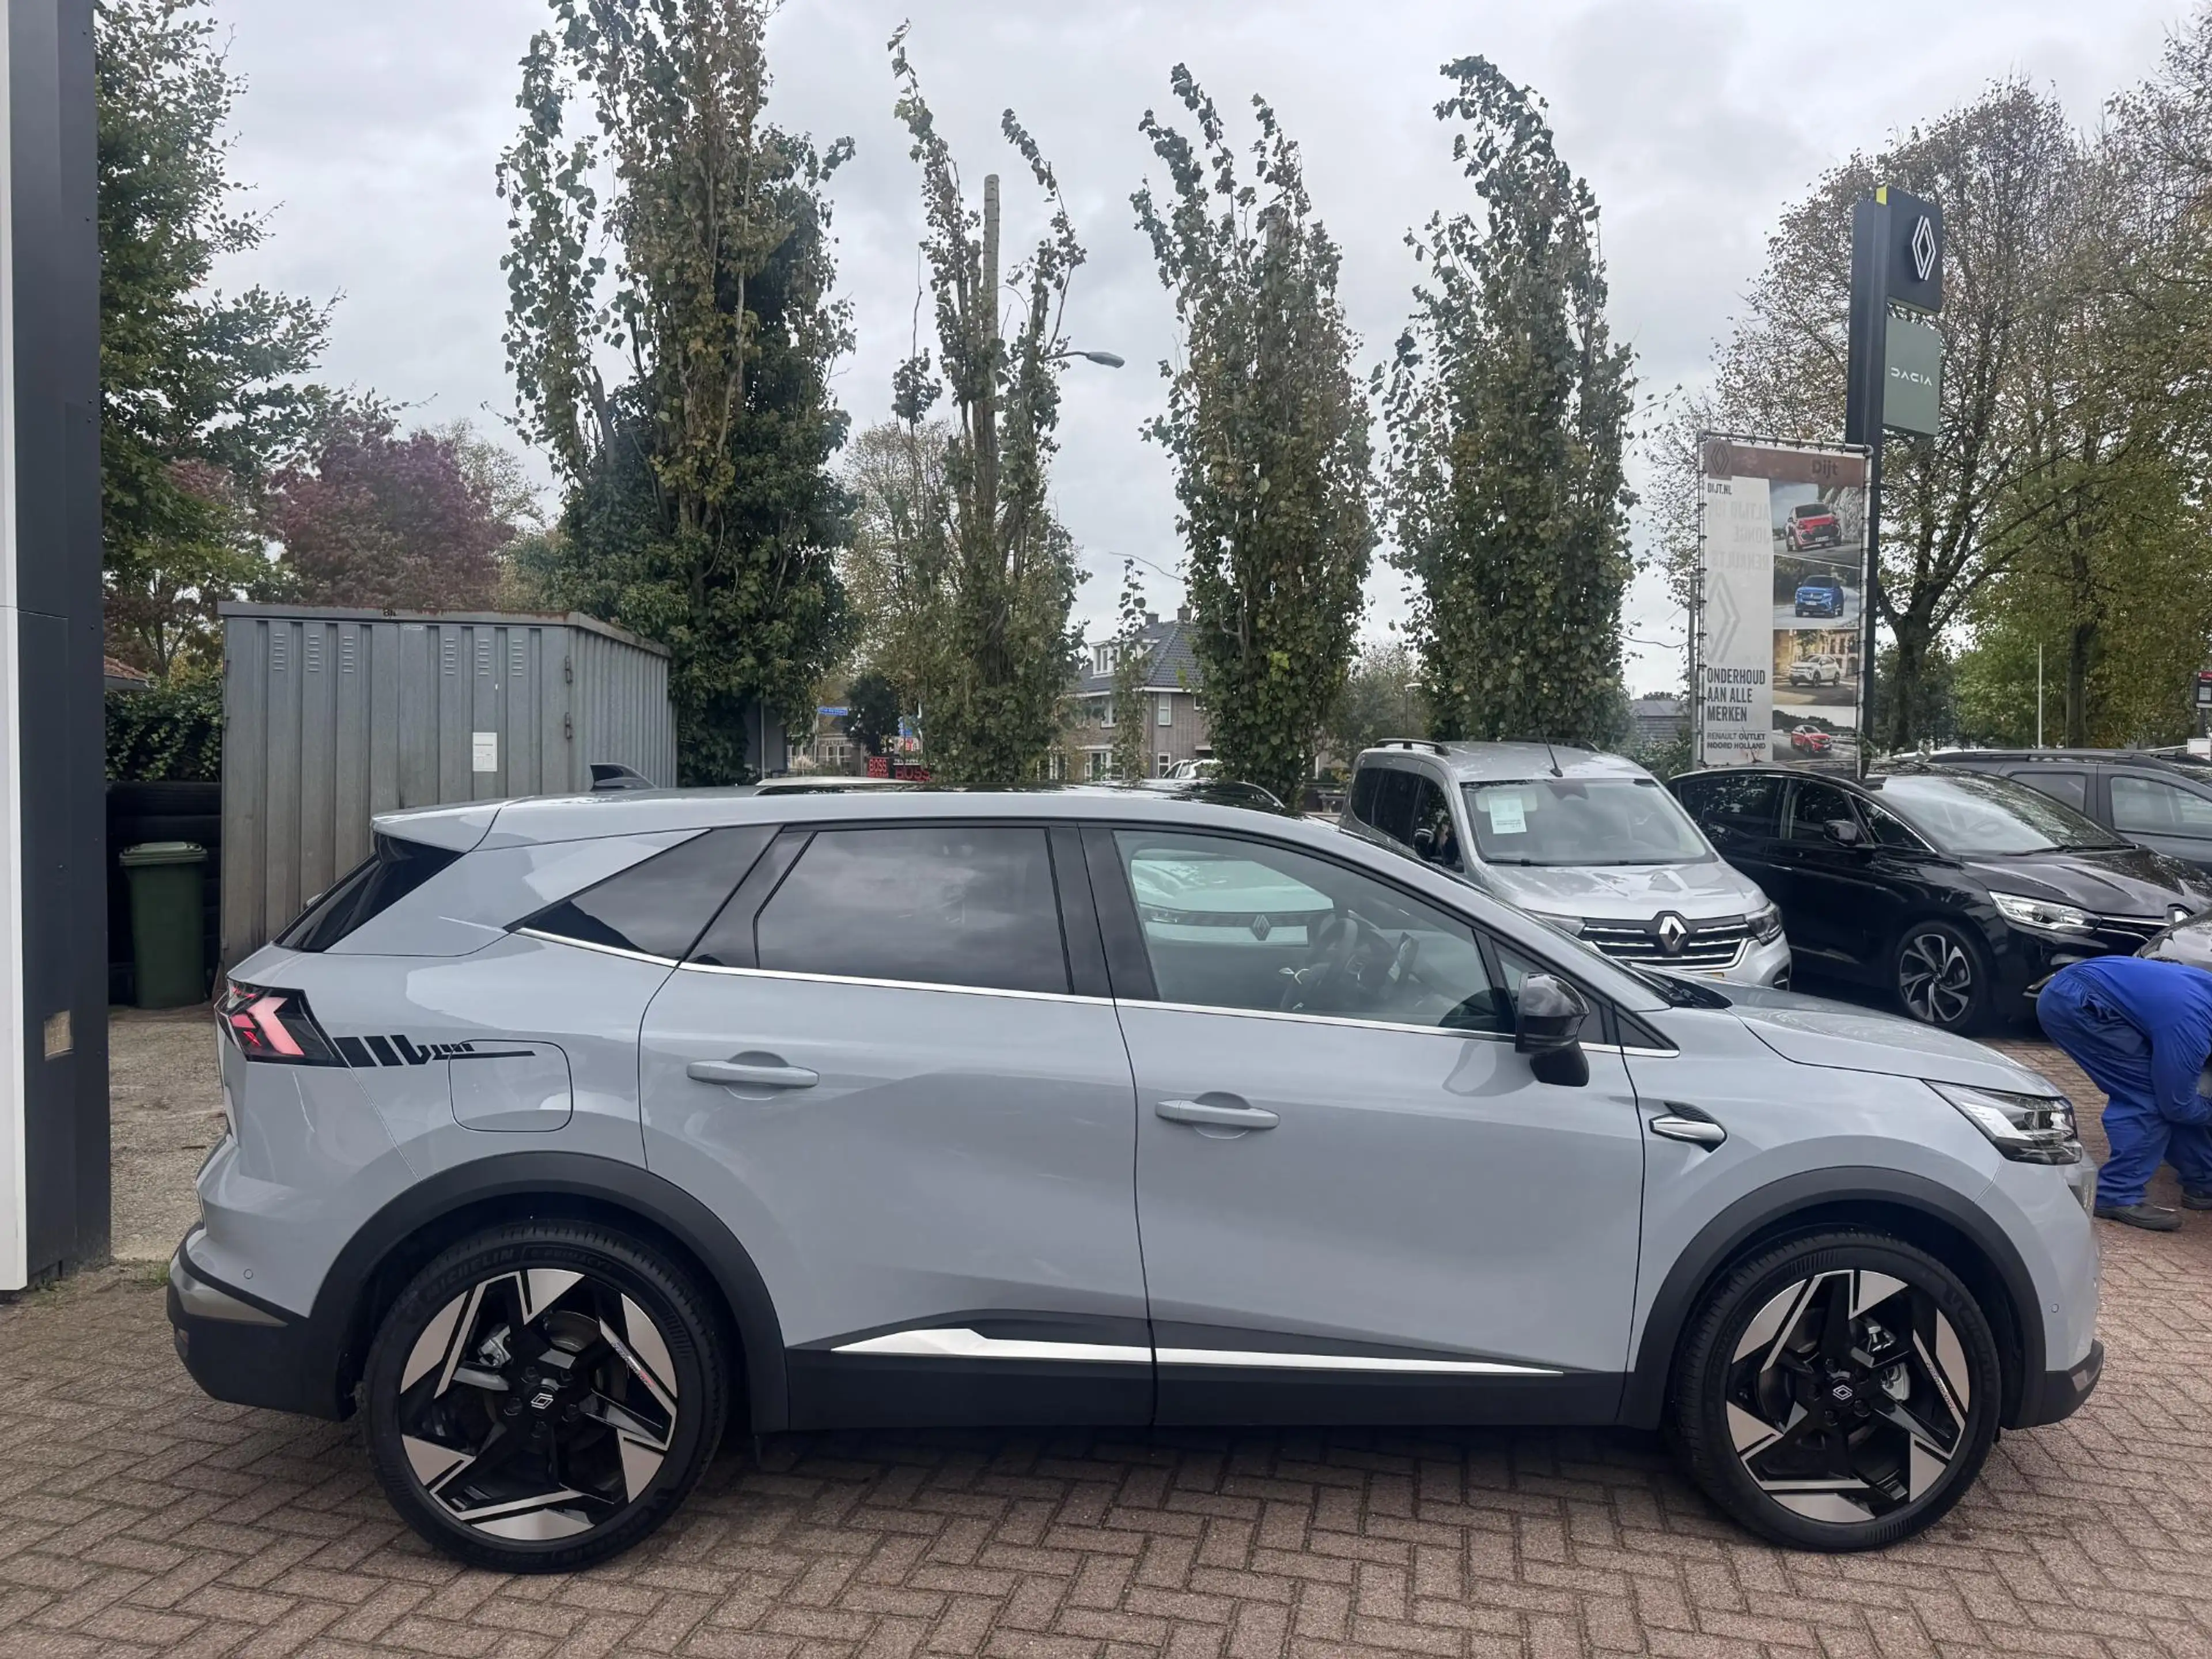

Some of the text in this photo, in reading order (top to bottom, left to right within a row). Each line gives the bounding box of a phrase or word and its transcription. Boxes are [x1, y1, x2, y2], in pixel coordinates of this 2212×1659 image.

[1891, 367, 1932, 387] DACIA
[1812, 460, 1838, 479] Dijt
[1707, 483, 1732, 495] DIJT.NL
[1707, 668, 1765, 684] ONDERHOUD
[1707, 687, 1753, 703] AAN ALLE
[1707, 705, 1747, 722] MERKEN
[869, 759, 887, 772] BOSS
